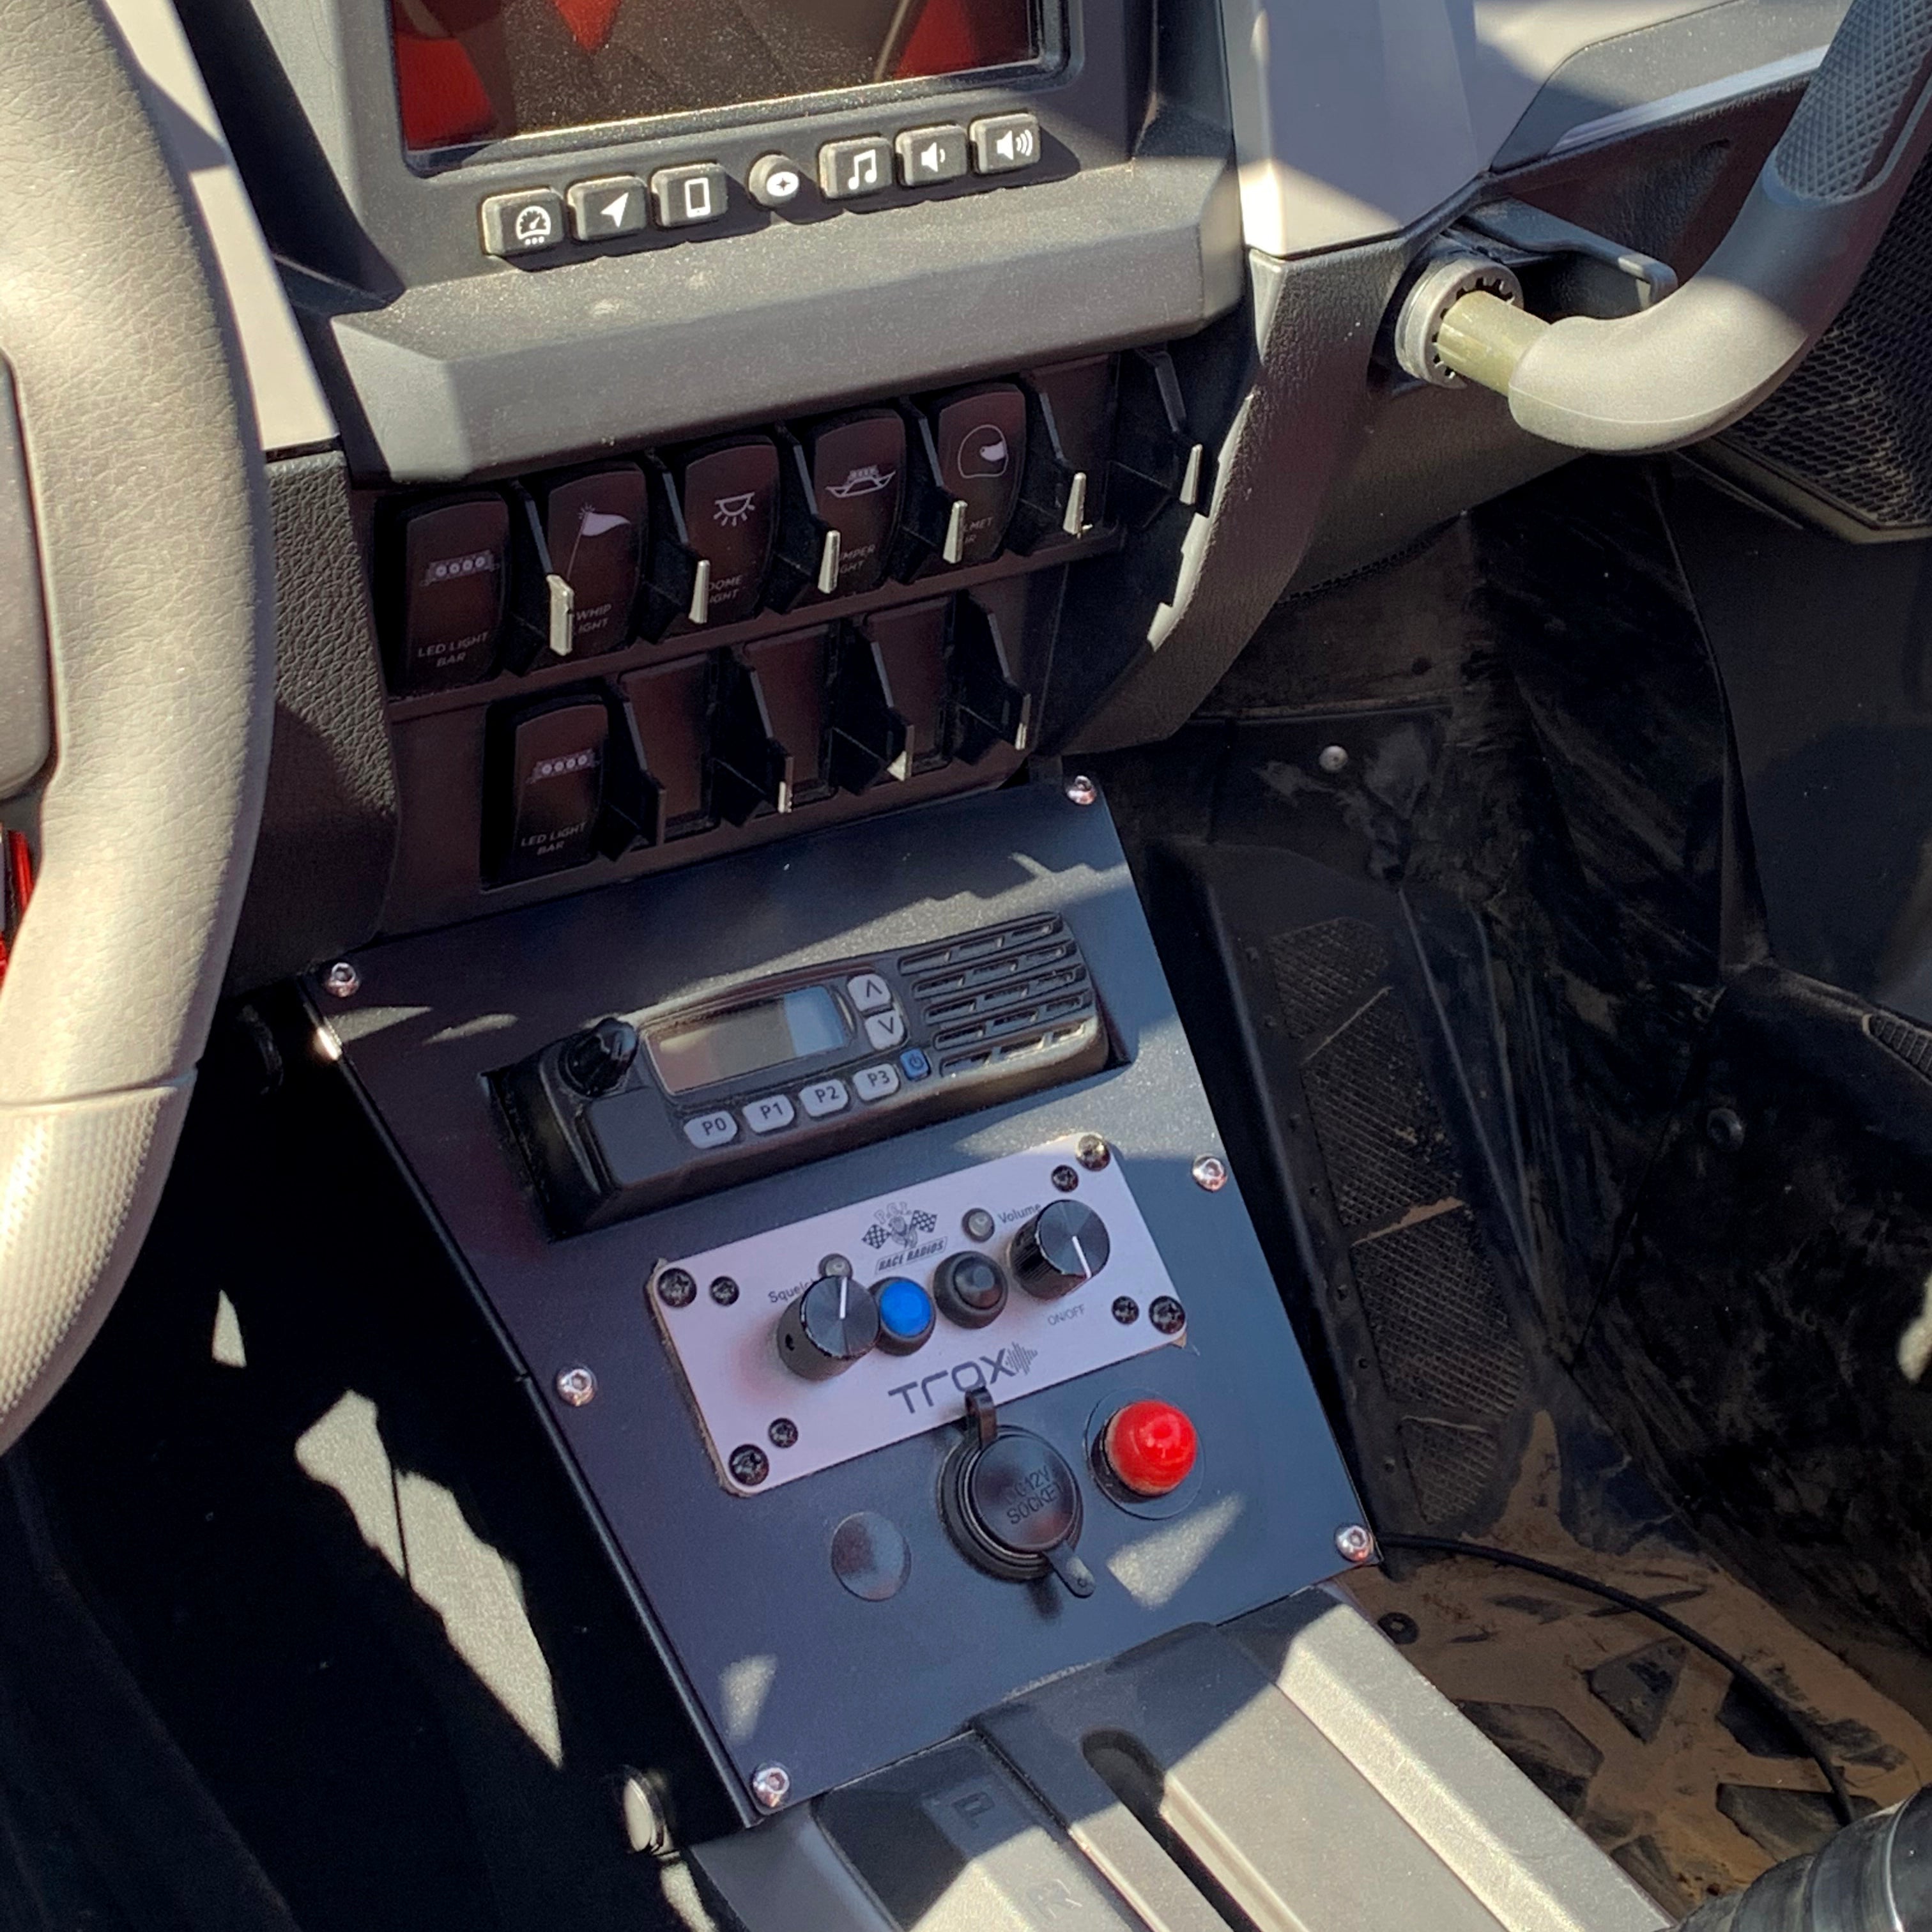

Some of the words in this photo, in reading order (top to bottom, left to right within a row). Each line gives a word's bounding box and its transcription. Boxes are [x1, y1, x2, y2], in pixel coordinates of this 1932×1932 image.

[839, 560, 866, 574] GHT
[709, 574, 744, 591] DOME
[709, 588, 739, 604] IGHT
[575, 603, 612, 621] WHIP
[578, 617, 609, 634] IGHT
[417, 643, 446, 657] LED
[448, 631, 489, 651] LIGHT
[436, 651, 466, 668] BAR
[521, 834, 547, 847] LED
[549, 820, 588, 841] LIGHT
[536, 840, 565, 856] BAR
[867, 1070, 891, 1087] P3
[814, 1086, 840, 1103] P2
[760, 1101, 784, 1119] P1
[702, 1119, 727, 1136] P0
[997, 1203, 1041, 1224] Volume
[878, 1254, 904, 1271] RACE
[906, 1239, 945, 1261] RADIOS
[1047, 1303, 1085, 1326] ON/OFF
[1006, 1482, 1064, 1524] SOCKET
